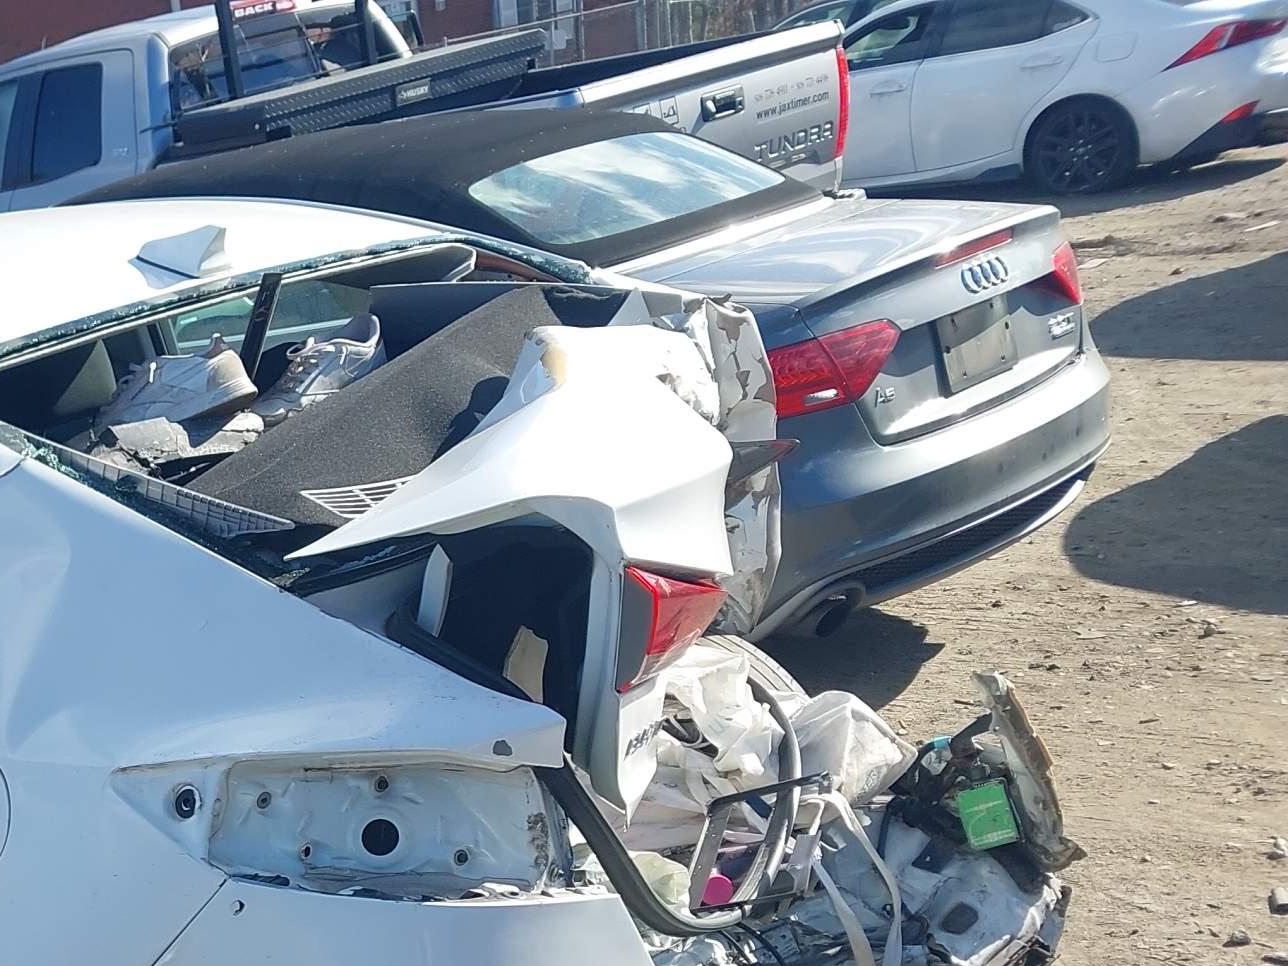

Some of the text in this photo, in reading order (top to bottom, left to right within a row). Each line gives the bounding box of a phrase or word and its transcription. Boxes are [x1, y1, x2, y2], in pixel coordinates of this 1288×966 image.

[234, 2, 274, 18] BACK
[755, 91, 830, 120] www.jaxtimer.com
[753, 120, 834, 163] TUNDRA
[874, 386, 896, 409] A5
